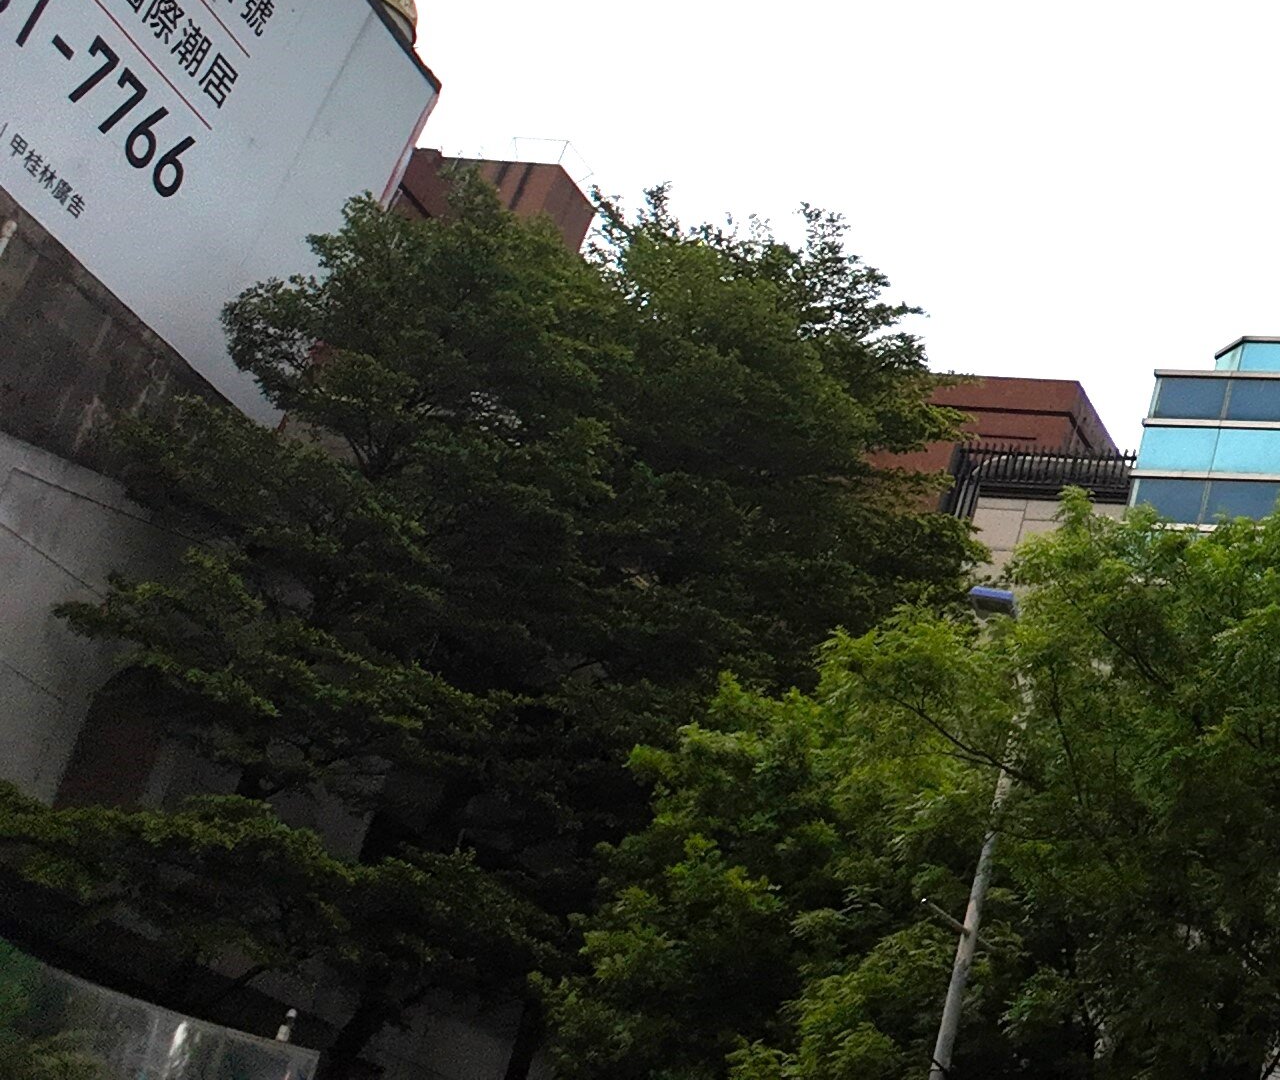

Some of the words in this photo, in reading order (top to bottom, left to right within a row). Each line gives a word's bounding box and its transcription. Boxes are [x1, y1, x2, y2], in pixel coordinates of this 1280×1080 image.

[9, 132, 86, 219] 甲桂林廣告
